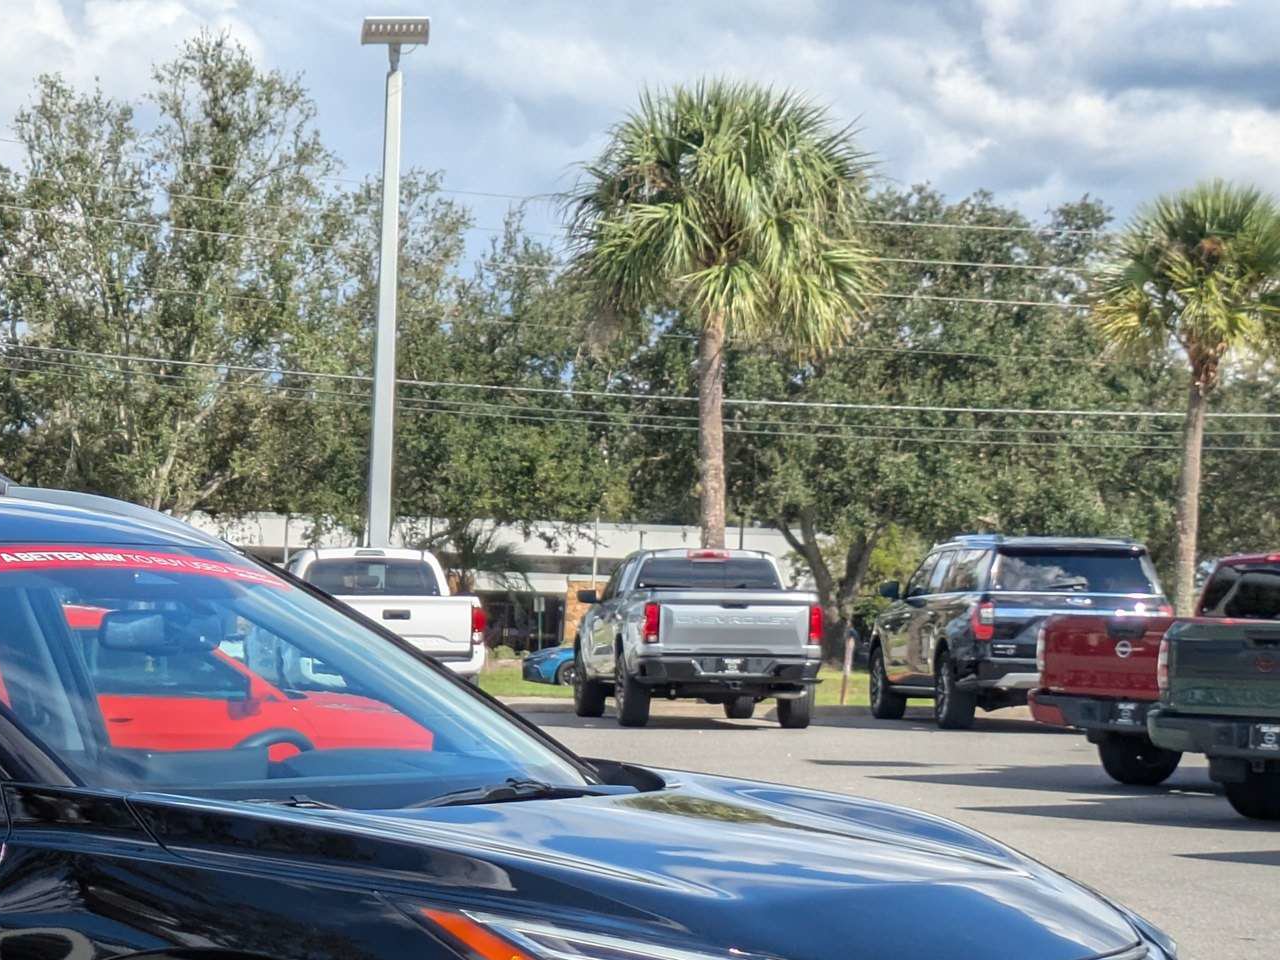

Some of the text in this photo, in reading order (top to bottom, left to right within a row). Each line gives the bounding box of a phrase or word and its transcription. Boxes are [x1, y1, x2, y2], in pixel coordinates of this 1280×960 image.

[0, 552, 13, 563] A
[13, 551, 85, 562] BETTER
[85, 552, 126, 562] WAY
[127, 554, 151, 563] TO
[674, 615, 795, 626] CHEVROLET
